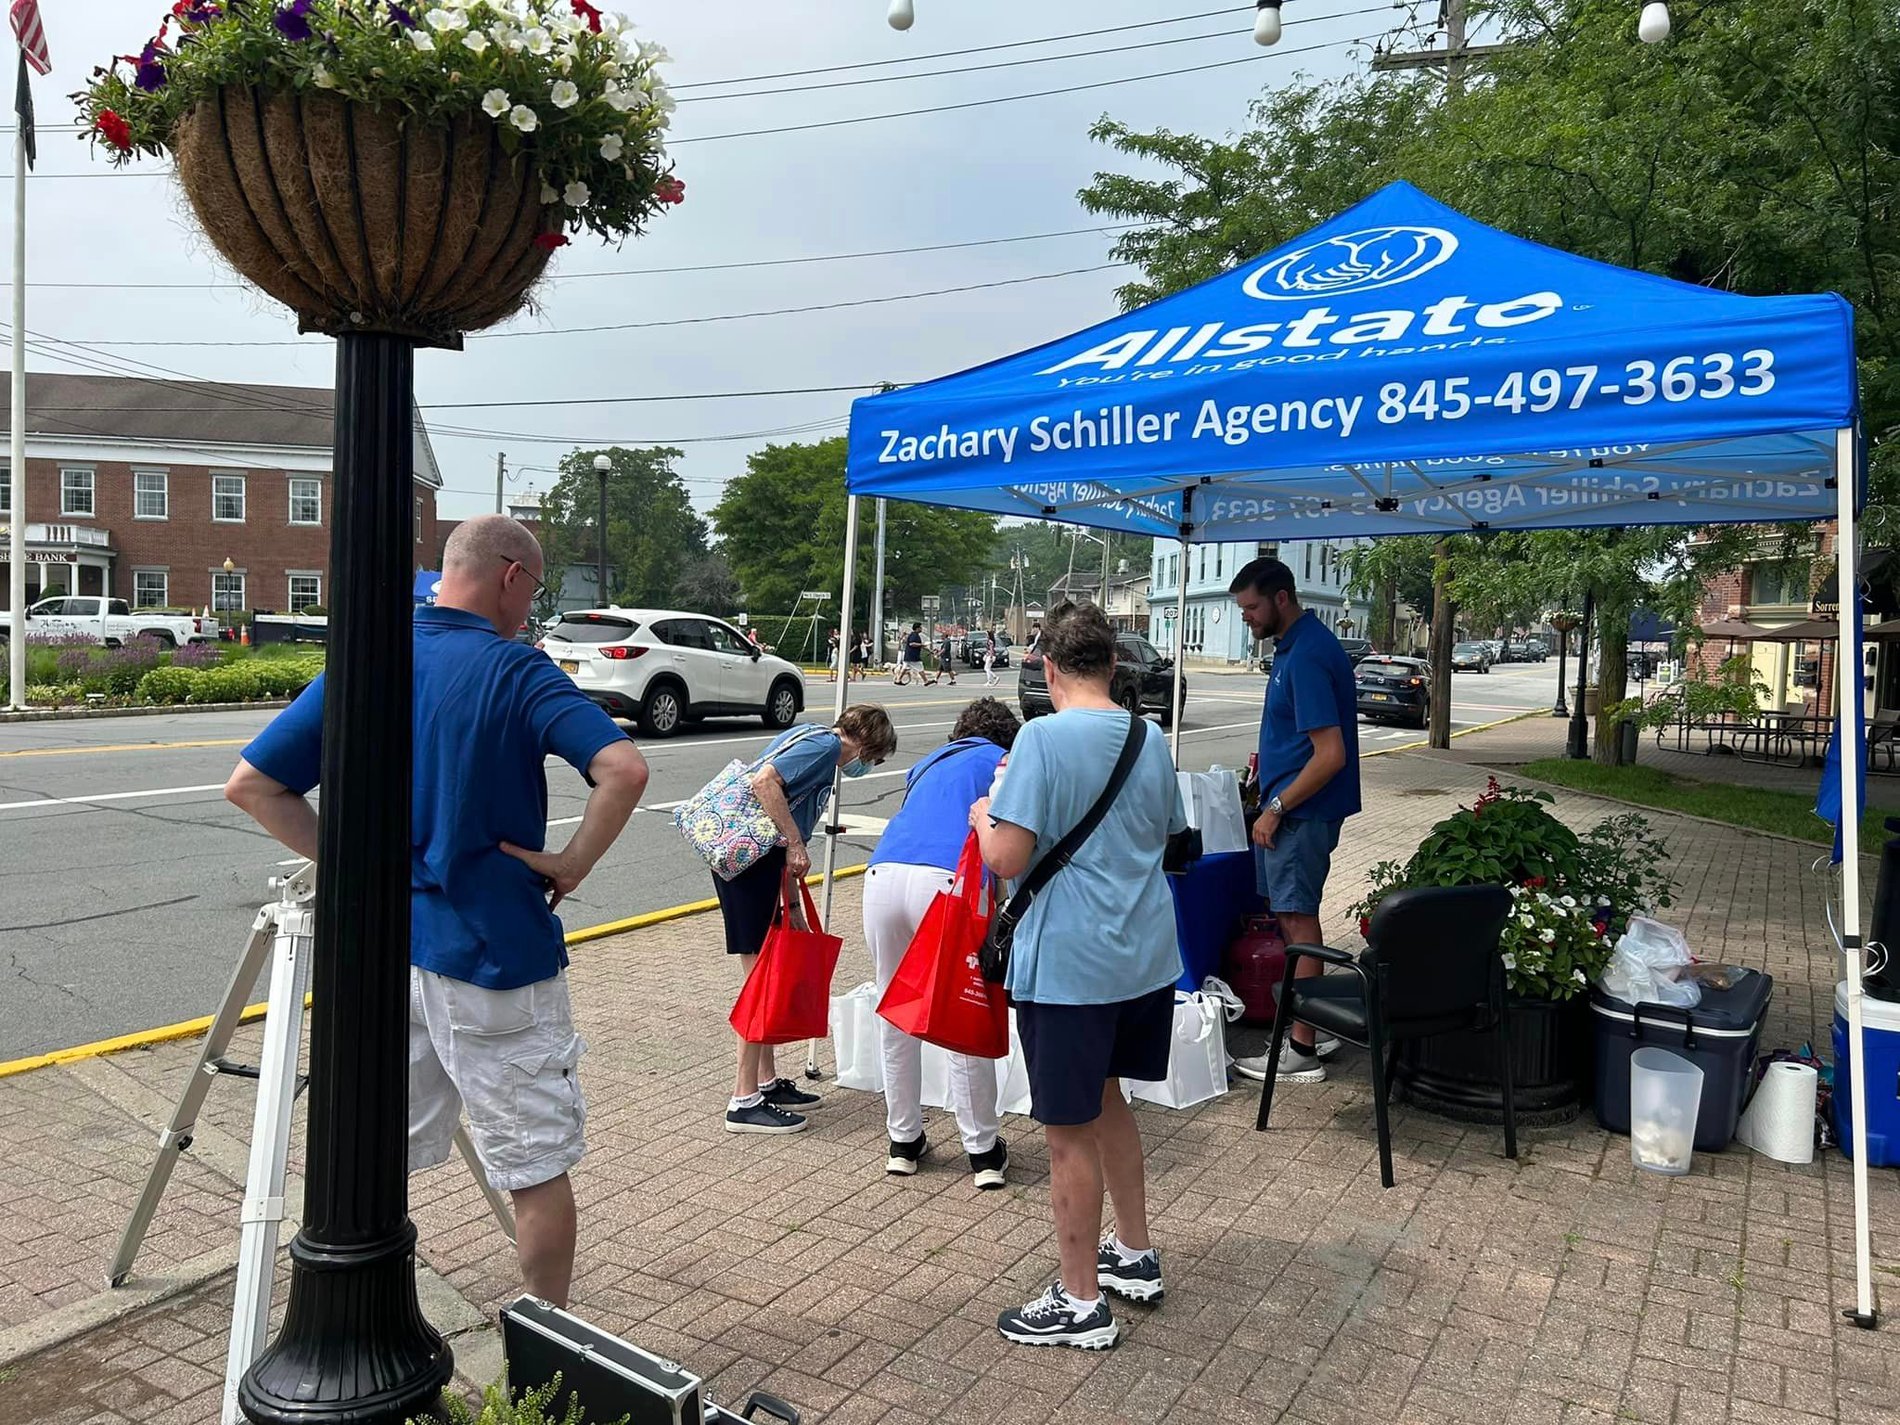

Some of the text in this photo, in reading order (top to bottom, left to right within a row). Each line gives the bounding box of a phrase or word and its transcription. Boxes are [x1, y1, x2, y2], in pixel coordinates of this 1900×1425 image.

[1032, 291, 1563, 376] Allstate
[1057, 369, 1174, 388] You're
[1183, 363, 1223, 376] in
[1227, 347, 1350, 371] good
[878, 348, 1776, 463] Zachary Schiller Agency 845-497-3633
[35, 552, 67, 562] BANK
